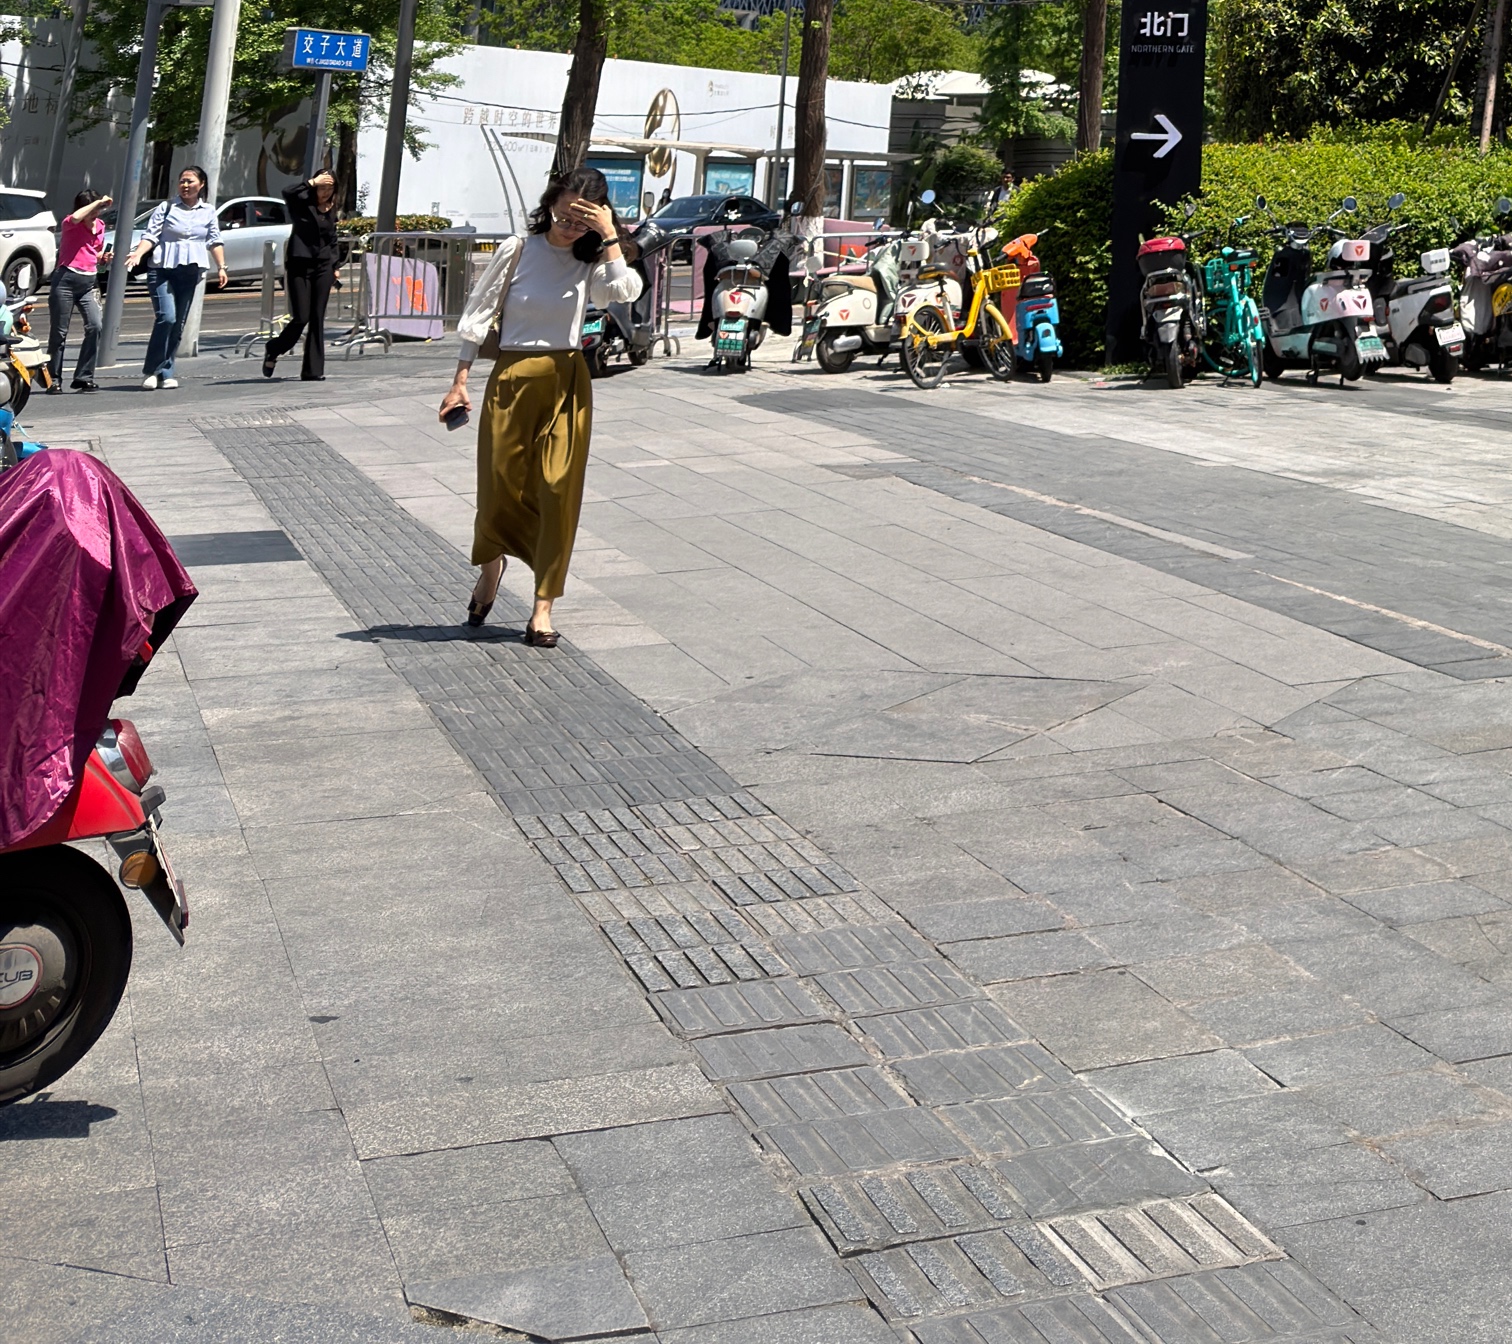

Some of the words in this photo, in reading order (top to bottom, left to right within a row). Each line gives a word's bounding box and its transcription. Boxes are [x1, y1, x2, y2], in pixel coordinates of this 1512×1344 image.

[1140, 11, 1189, 37] 北门
[302, 34, 363, 58] 交子大道
[1131, 44, 1174, 53] NORTHERN
[1176, 44, 1195, 53] GATE
[463, 107, 557, 129] 跨越时空的世界
[0, 970, 33, 983] UB
